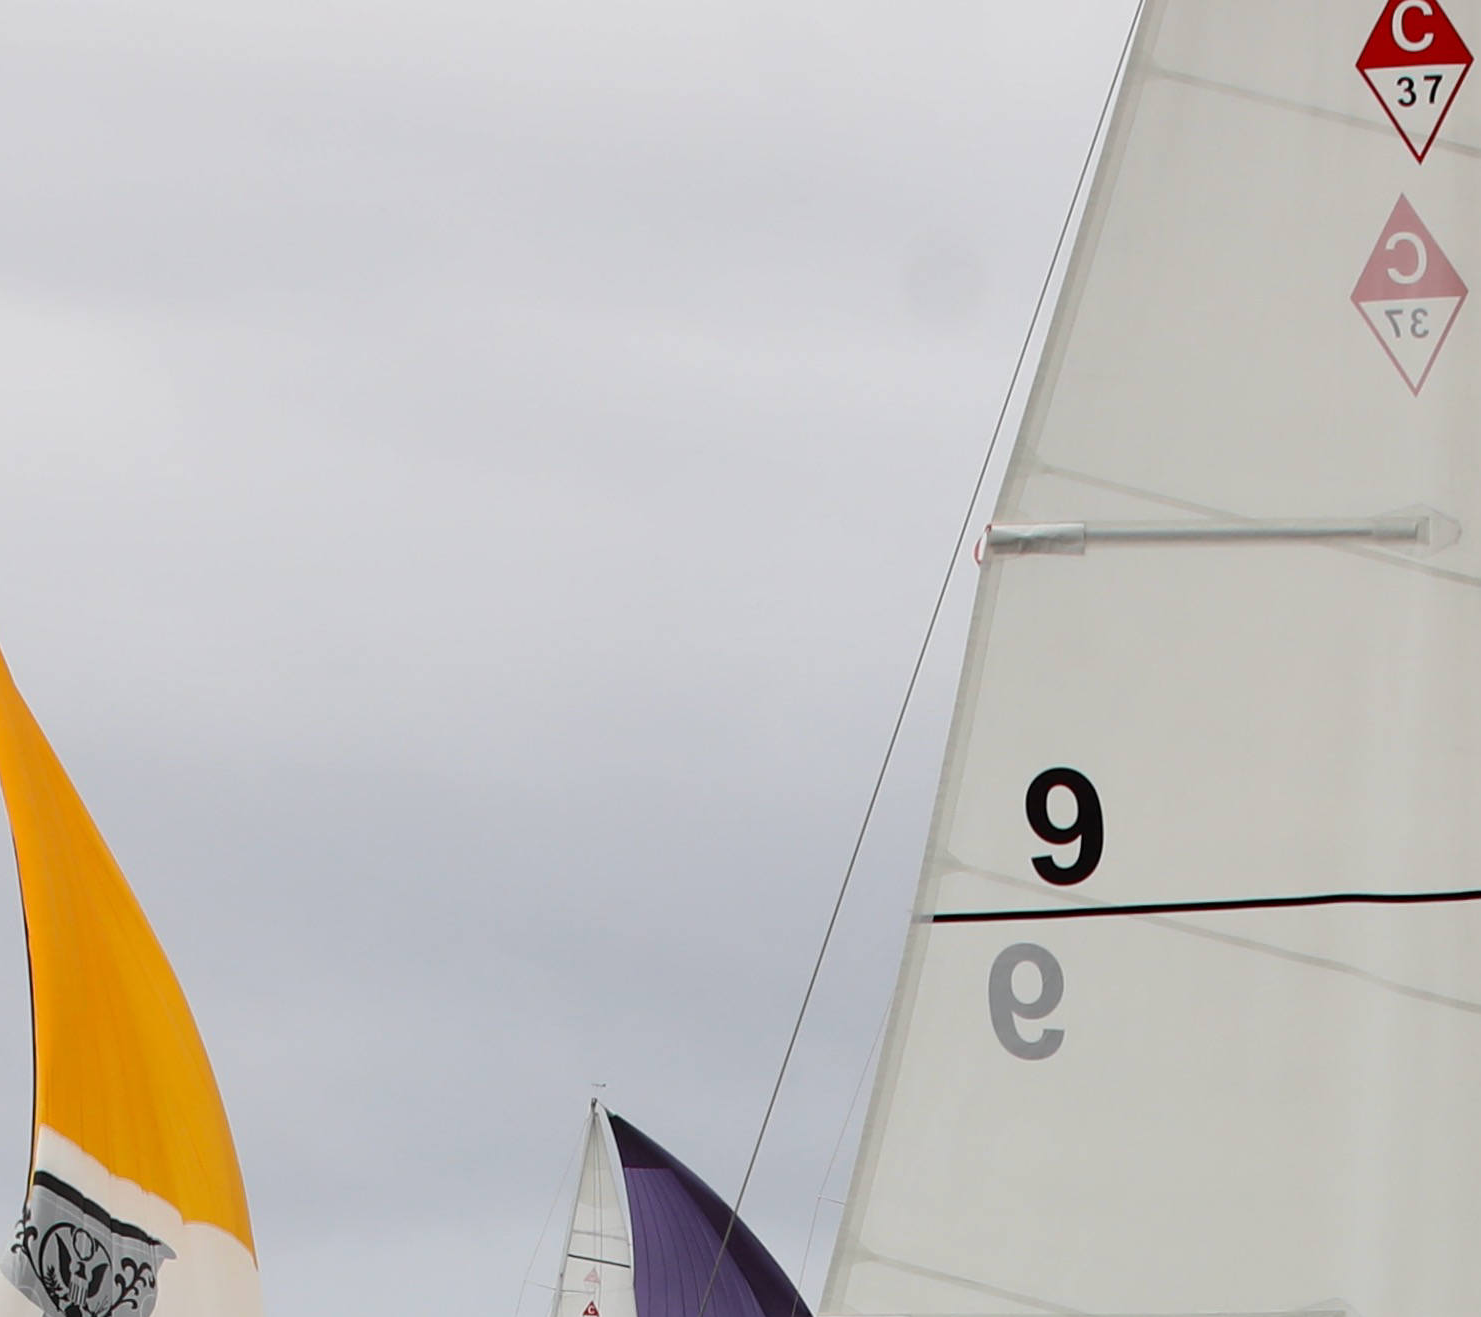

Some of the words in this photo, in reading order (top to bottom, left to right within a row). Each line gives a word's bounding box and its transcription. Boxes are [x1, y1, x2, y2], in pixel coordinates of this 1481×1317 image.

[1392, 0, 1434, 52] C
[1397, 75, 1443, 107] 37
[1025, 767, 1103, 886] 9
